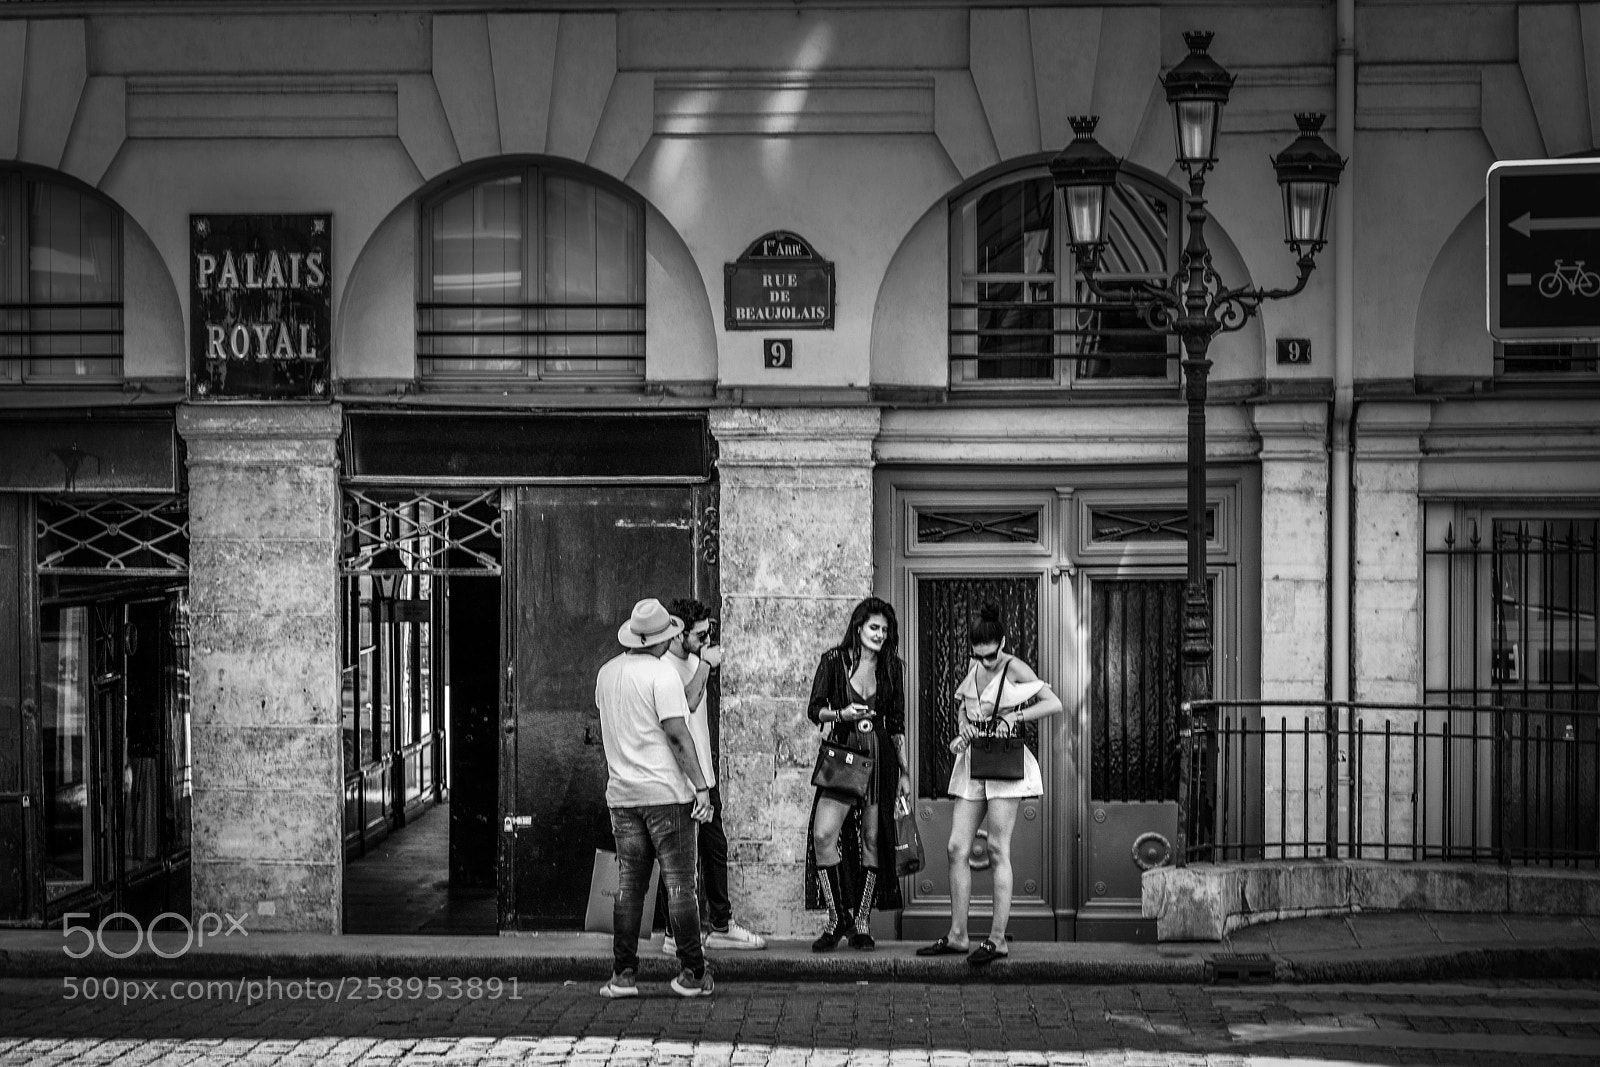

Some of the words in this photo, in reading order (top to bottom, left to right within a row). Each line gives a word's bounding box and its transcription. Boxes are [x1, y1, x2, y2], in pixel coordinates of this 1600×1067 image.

[197, 250, 325, 288] PALAIS
[762, 274, 798, 287] RUE
[769, 291, 790, 303] DE
[735, 306, 825, 320] BEAUJOLAIS
[206, 321, 317, 360] ROYAL
[770, 341, 787, 367] 9
[1288, 341, 1301, 362] 9
